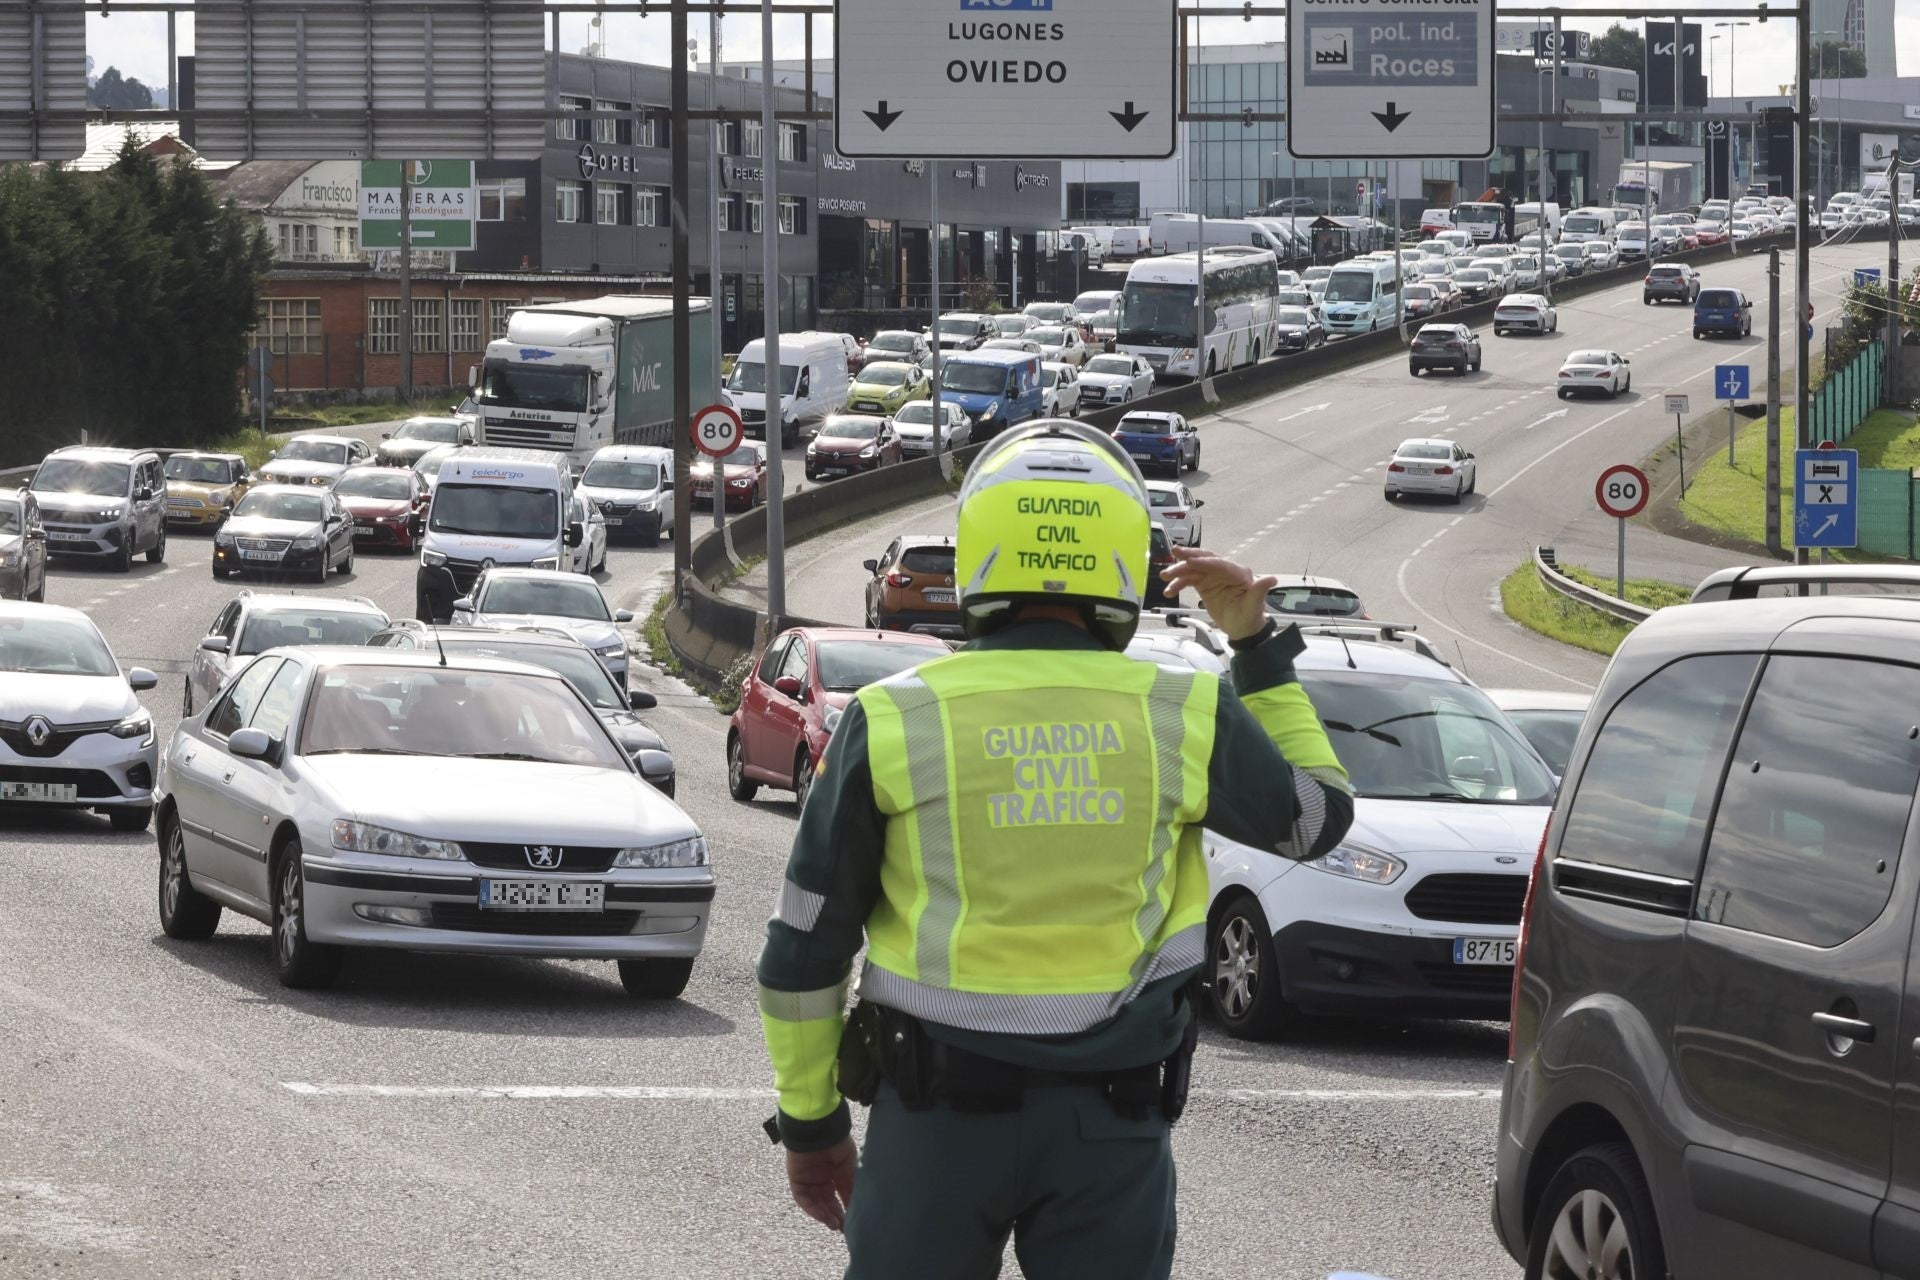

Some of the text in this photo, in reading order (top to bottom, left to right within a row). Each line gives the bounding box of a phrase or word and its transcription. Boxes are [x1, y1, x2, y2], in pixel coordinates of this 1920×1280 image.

[948, 22, 1065, 41] LUGONES
[1370, 22, 1461, 43] pol. ind.
[946, 60, 1068, 84] OVIEDO
[1370, 53, 1456, 77] Roces
[599, 155, 639, 173] OPEL
[302, 176, 352, 203] Francisco
[367, 192, 465, 205] MAERAS
[510, 410, 552, 421] Asturias
[703, 422, 732, 439] 80
[472, 469, 524, 479] telefurgo
[1608, 483, 1637, 500] 80
[1017, 497, 1102, 518] GUARDIA
[1037, 525, 1081, 544] CIVIL
[1017, 548, 1096, 571] TRÁFICO
[984, 722, 1122, 757] GUARDIA
[1014, 756, 1098, 790] CIVIL
[988, 789, 1124, 826] TRAFICO
[1466, 941, 1515, 962] 8715
